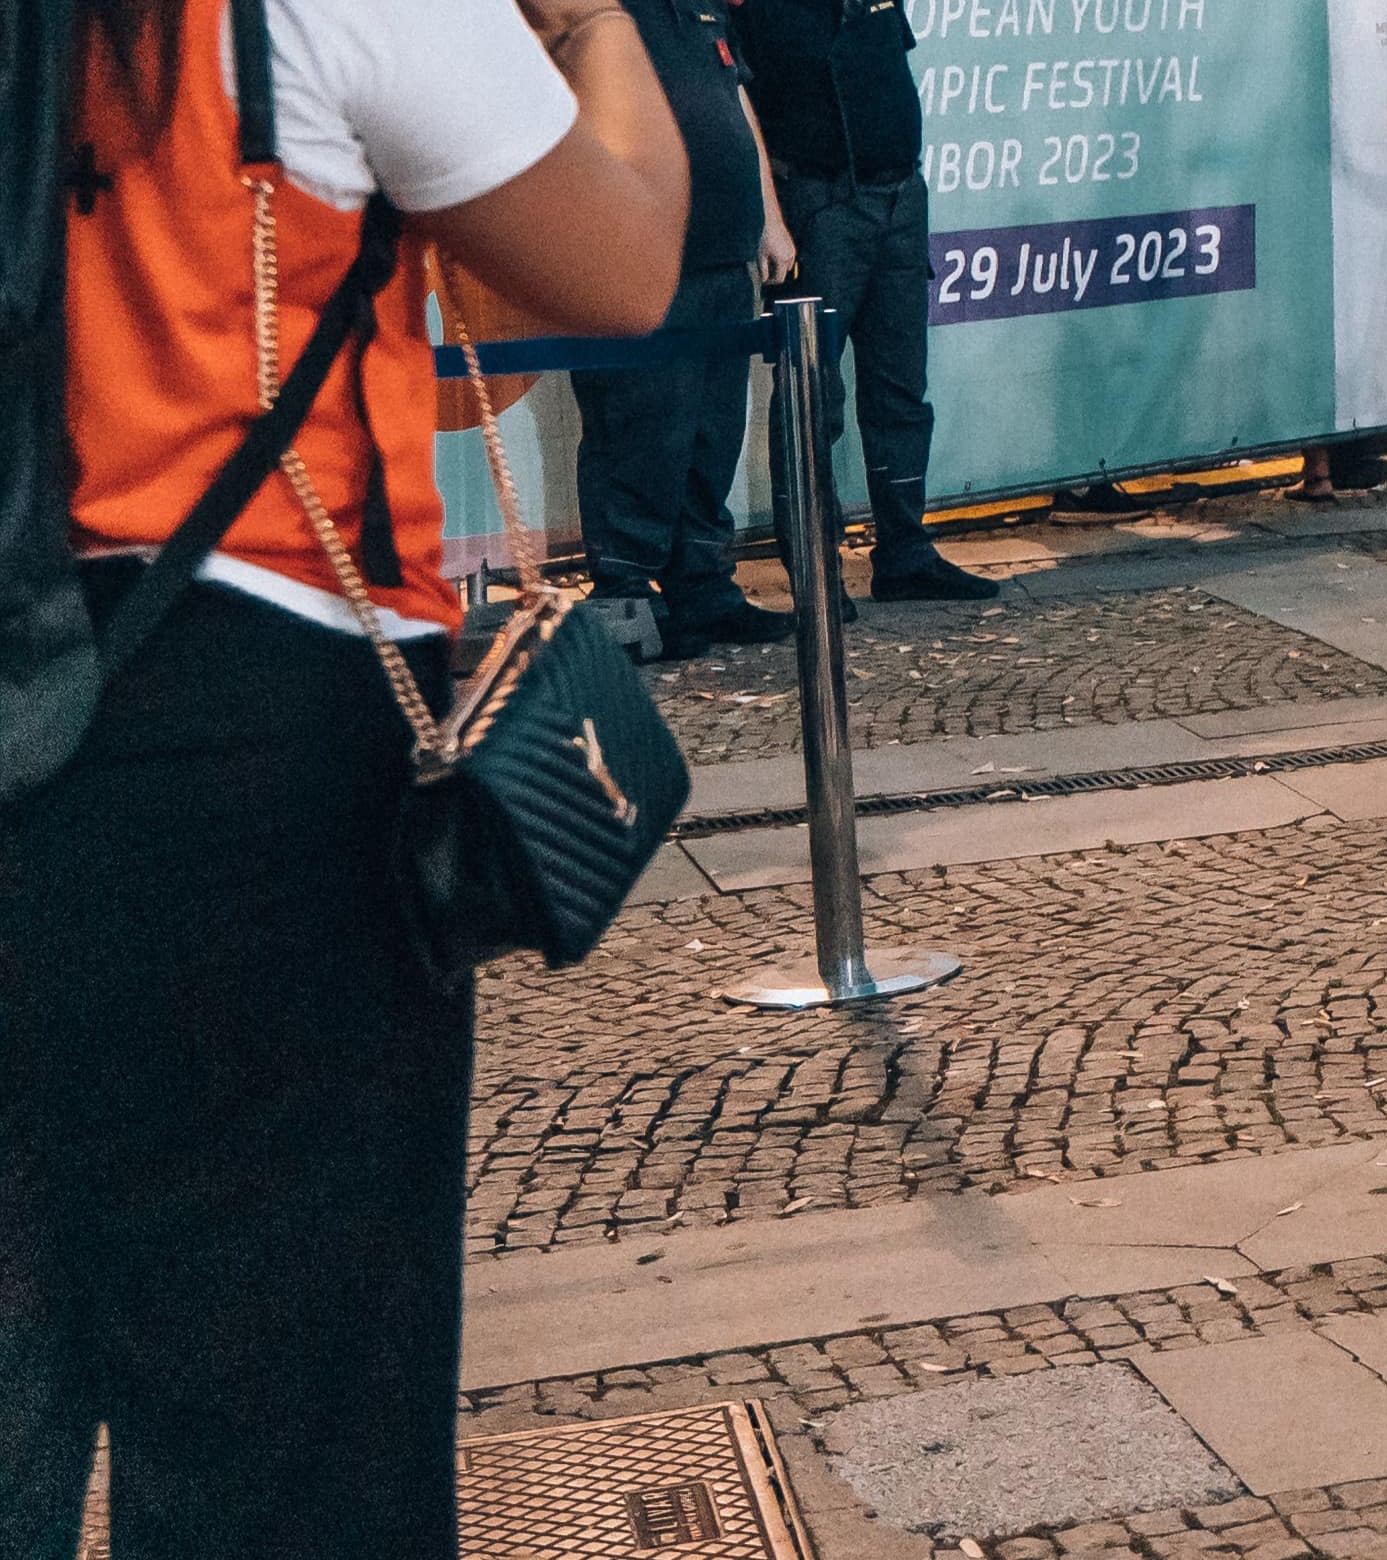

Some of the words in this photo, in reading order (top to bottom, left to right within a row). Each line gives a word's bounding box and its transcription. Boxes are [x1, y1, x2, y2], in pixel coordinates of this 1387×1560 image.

[1021, 55, 1205, 111] FESTIVAL
[1038, 131, 1141, 186] 2023
[937, 245, 999, 304] 29
[1010, 236, 1099, 303] July
[1109, 223, 1222, 285] 2023
